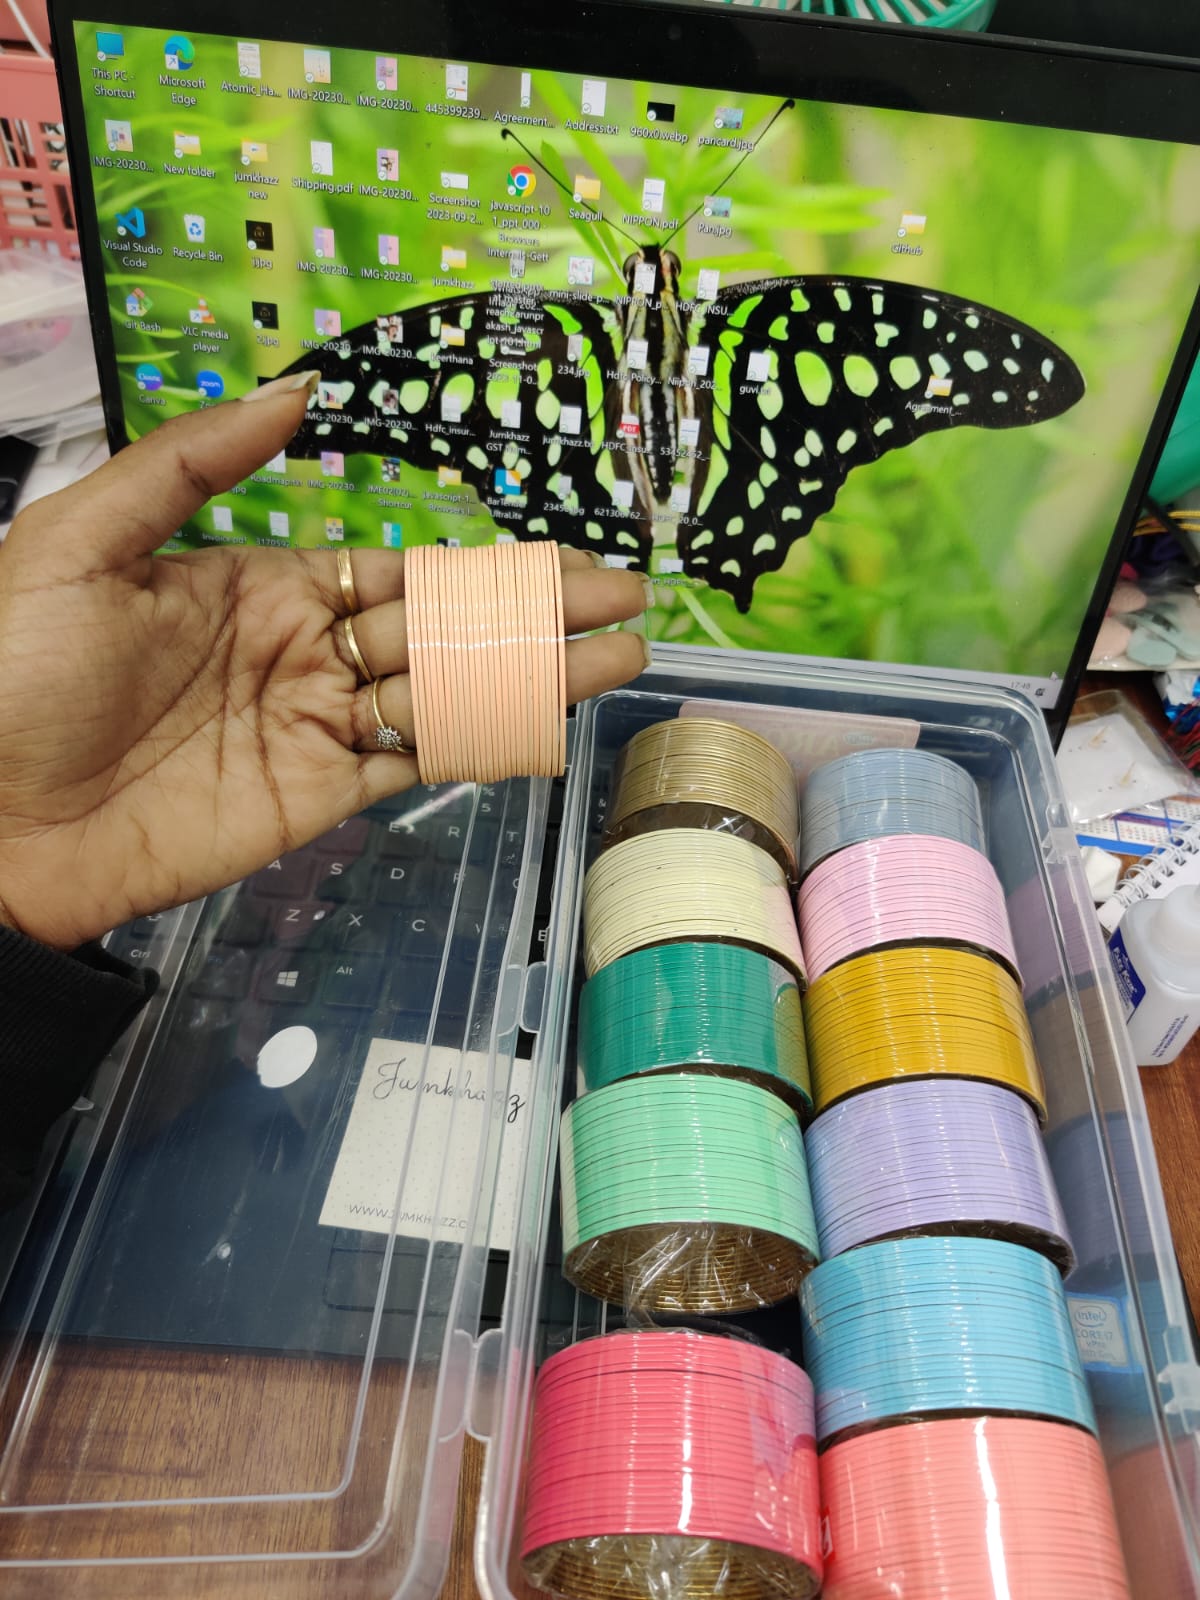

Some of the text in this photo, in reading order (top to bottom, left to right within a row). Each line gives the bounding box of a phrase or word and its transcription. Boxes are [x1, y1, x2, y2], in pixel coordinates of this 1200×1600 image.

[92, 67, 111, 79] This
[113, 69, 127, 80] PC
[159, 74, 207, 89] Microsoft
[94, 85, 136, 99] Shortcut
[287, 87, 351, 105] IMG-20230...
[171, 92, 198, 108] Edge
[356, 95, 419, 113] IMG-20230...
[565, 119, 619, 135] Address.txt
[630, 126, 688, 143] 960x0.webp
[163, 163, 216, 179] New folder
[291, 177, 353, 194] Shipping.pdf
[248, 189, 268, 200] new
[429, 193, 480, 208] Screenshot
[569, 207, 603, 222] Seagull
[622, 213, 678, 231] NIPPON.pdf
[698, 222, 732, 238] Pan.jpg
[103, 239, 163, 256] Visual Studio
[173, 247, 223, 262] Recycle Bin
[122, 256, 148, 268] Code
[140, 322, 161, 333] Bash
[181, 326, 229, 341] VLC media
[193, 342, 220, 354] player
[138, 394, 166, 406] Canva
[489, 430, 530, 442] Jumkhazz
[486, 442, 503, 452] GST
[481, 803, 492, 813] 5
[388, 822, 401, 834] E
[448, 826, 461, 839] R
[506, 831, 519, 842] T
[267, 859, 283, 871] A
[330, 863, 342, 876] S
[390, 868, 405, 880] D
[285, 908, 301, 922] Z
[347, 914, 364, 927] X
[411, 919, 426, 932] C
[130, 949, 151, 959] Ctrl
[336, 966, 353, 976] Alt
